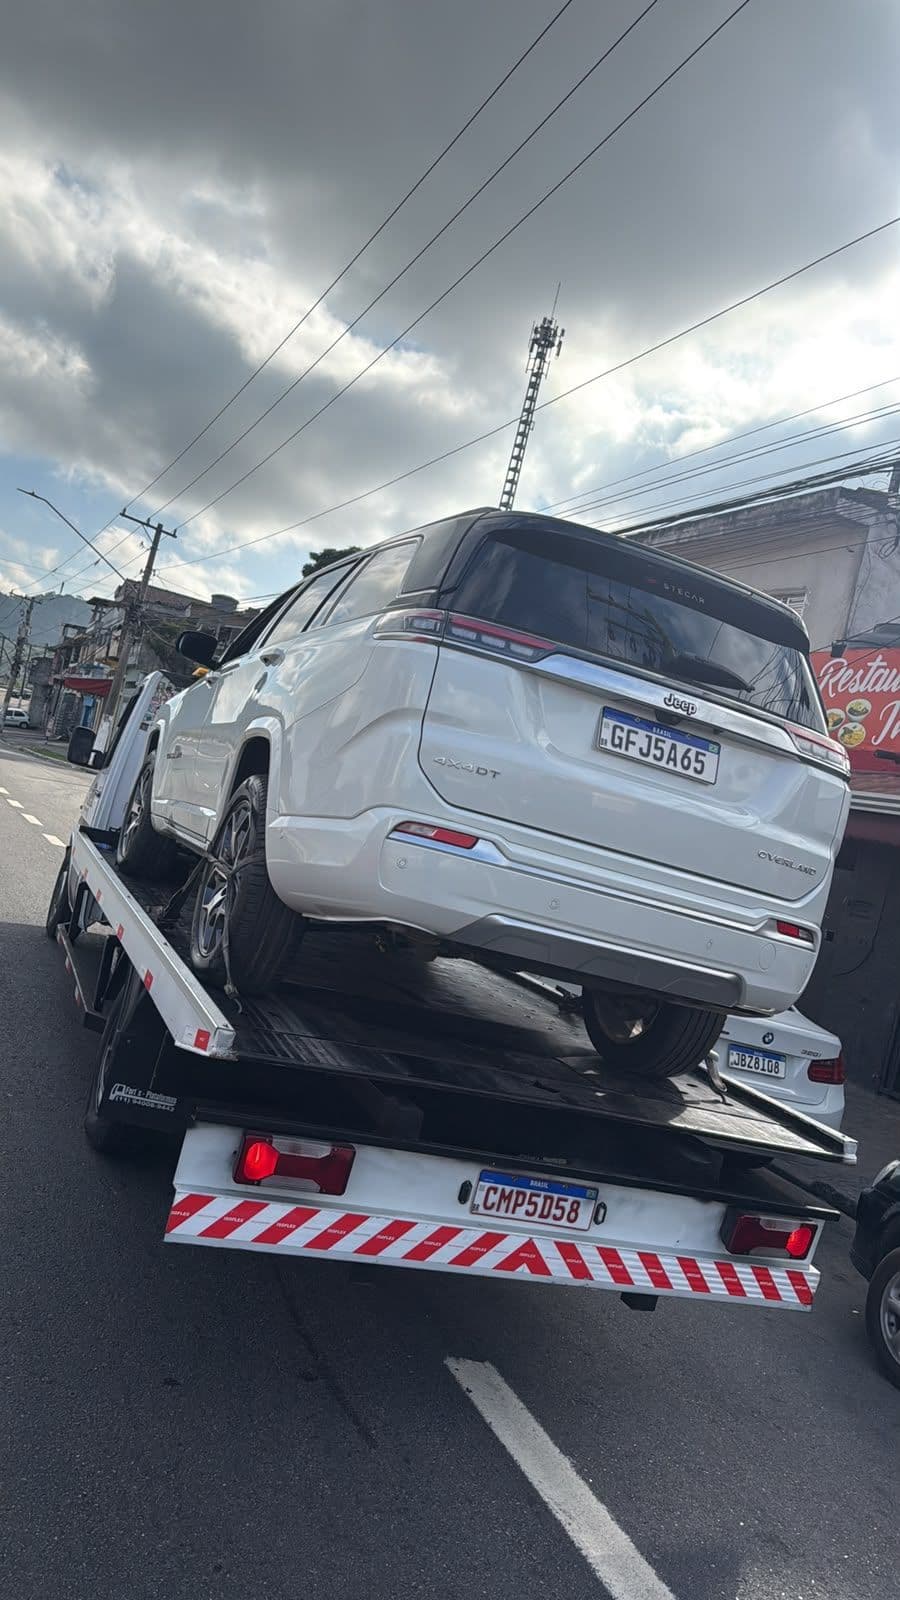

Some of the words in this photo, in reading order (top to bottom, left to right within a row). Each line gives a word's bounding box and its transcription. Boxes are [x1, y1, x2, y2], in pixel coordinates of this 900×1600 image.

[663, 693, 698, 716] Jeep
[651, 726, 672, 738] BRASIL
[610, 724, 706, 775] GFJ5A65
[758, 850, 817, 876] OVERLAND
[529, 1179, 549, 1189] BRASIL
[483, 1185, 581, 1223] CMP5D58
